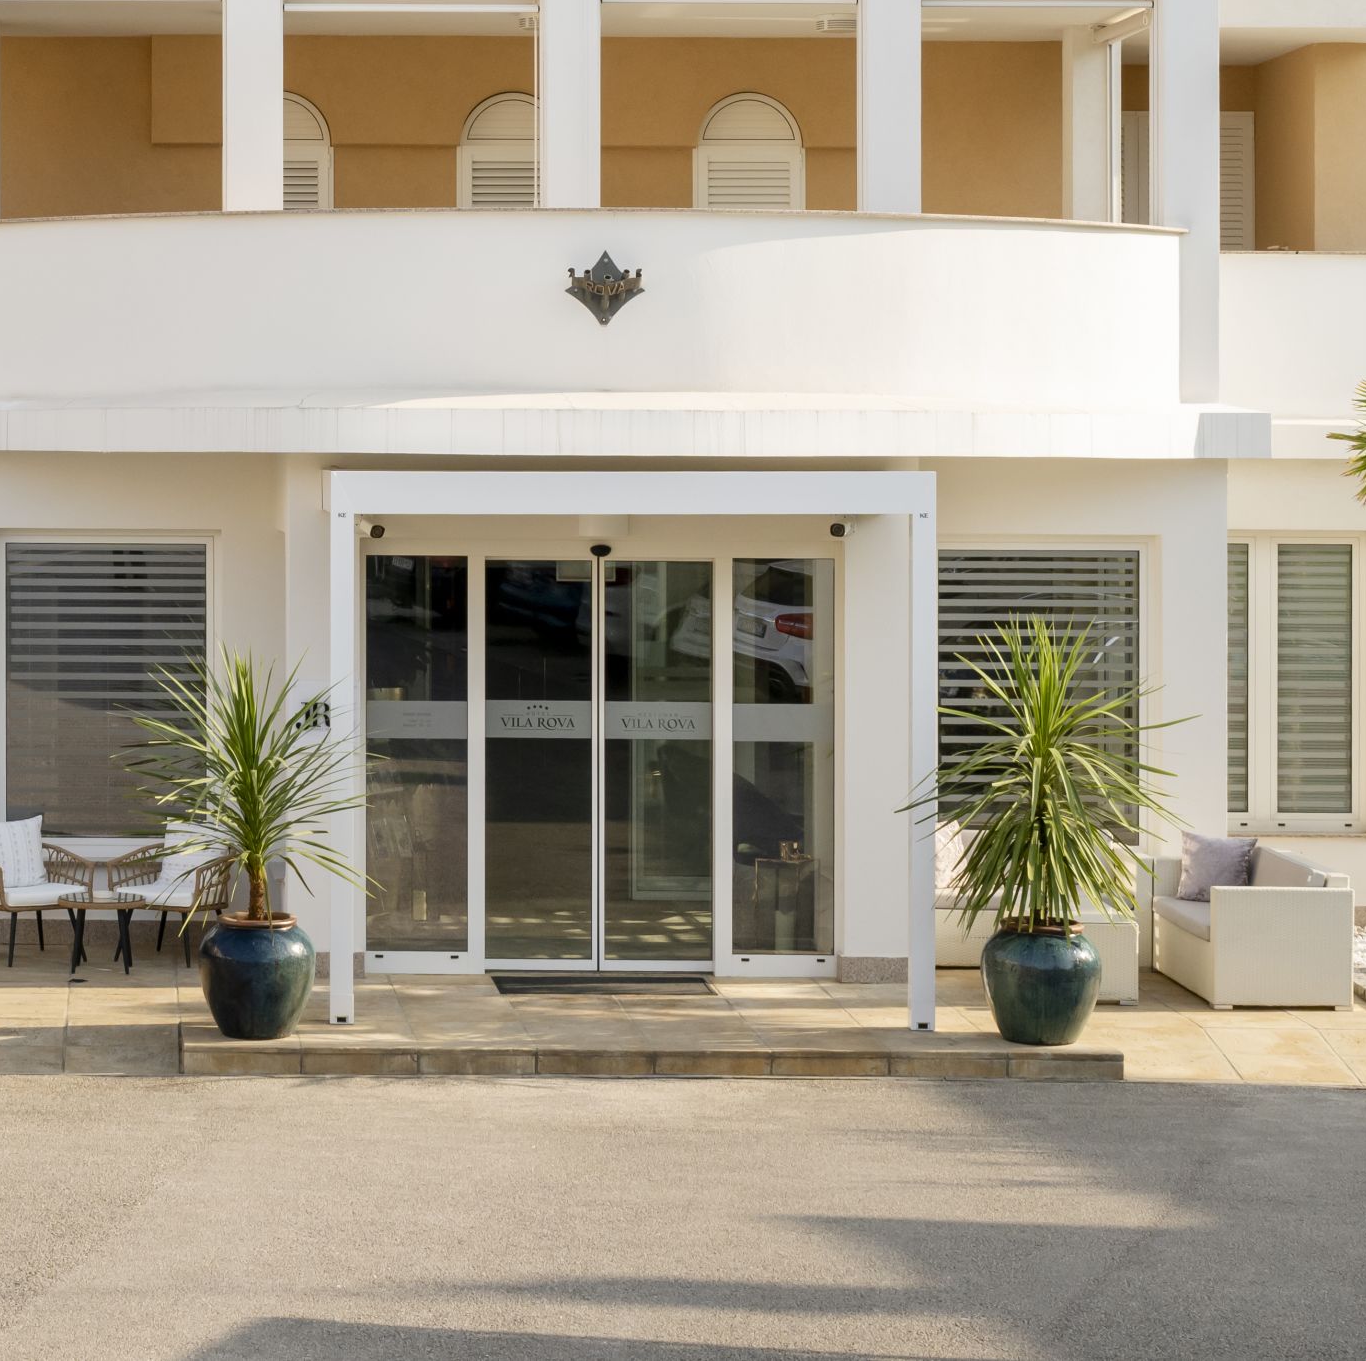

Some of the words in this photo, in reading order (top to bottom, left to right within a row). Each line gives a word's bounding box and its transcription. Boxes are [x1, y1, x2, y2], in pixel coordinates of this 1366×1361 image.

[585, 281, 625, 296] ROVA
[500, 717, 533, 728] VILA
[537, 717, 576, 731] ROVA
[621, 718, 653, 729] VILA
[658, 719, 696, 733] ROVA
